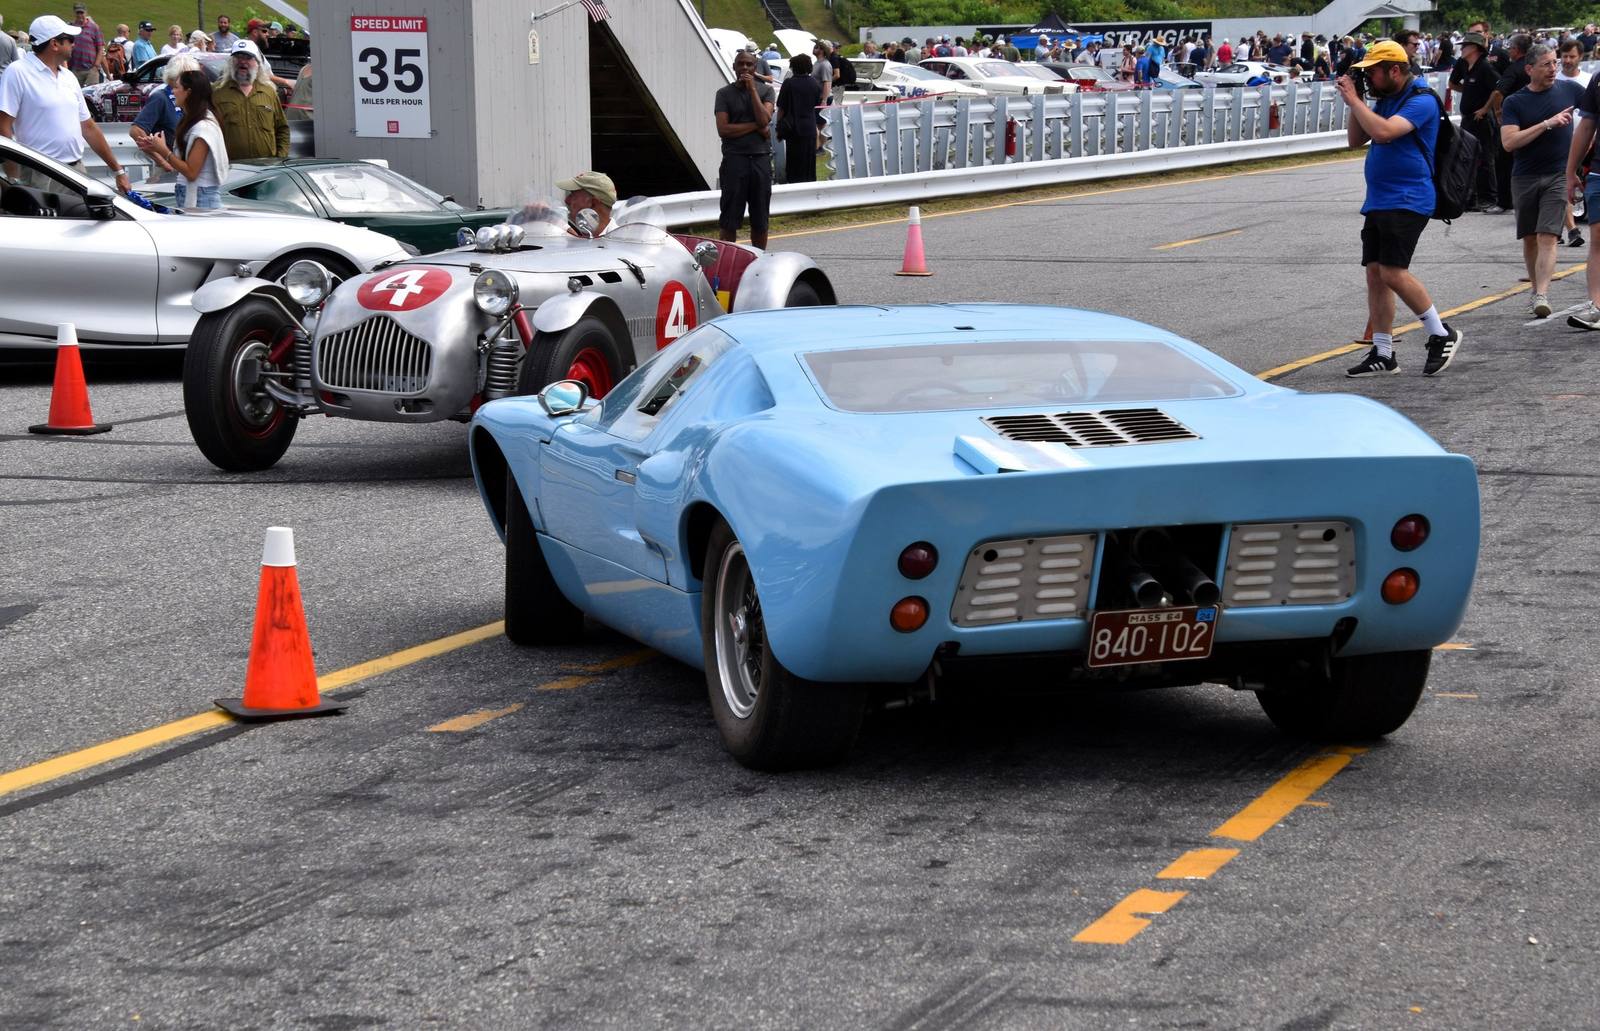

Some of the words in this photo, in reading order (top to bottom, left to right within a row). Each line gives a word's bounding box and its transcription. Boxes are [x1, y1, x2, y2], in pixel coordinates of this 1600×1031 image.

[354, 18, 390, 29] SPEED
[392, 19, 423, 30] LIMIT
[358, 47, 424, 94] 35
[117, 95, 129, 105] 197
[372, 269, 430, 307] 4
[664, 290, 689, 339] 4
[1129, 613, 1161, 624] MASS
[1166, 612, 1182, 621] 64
